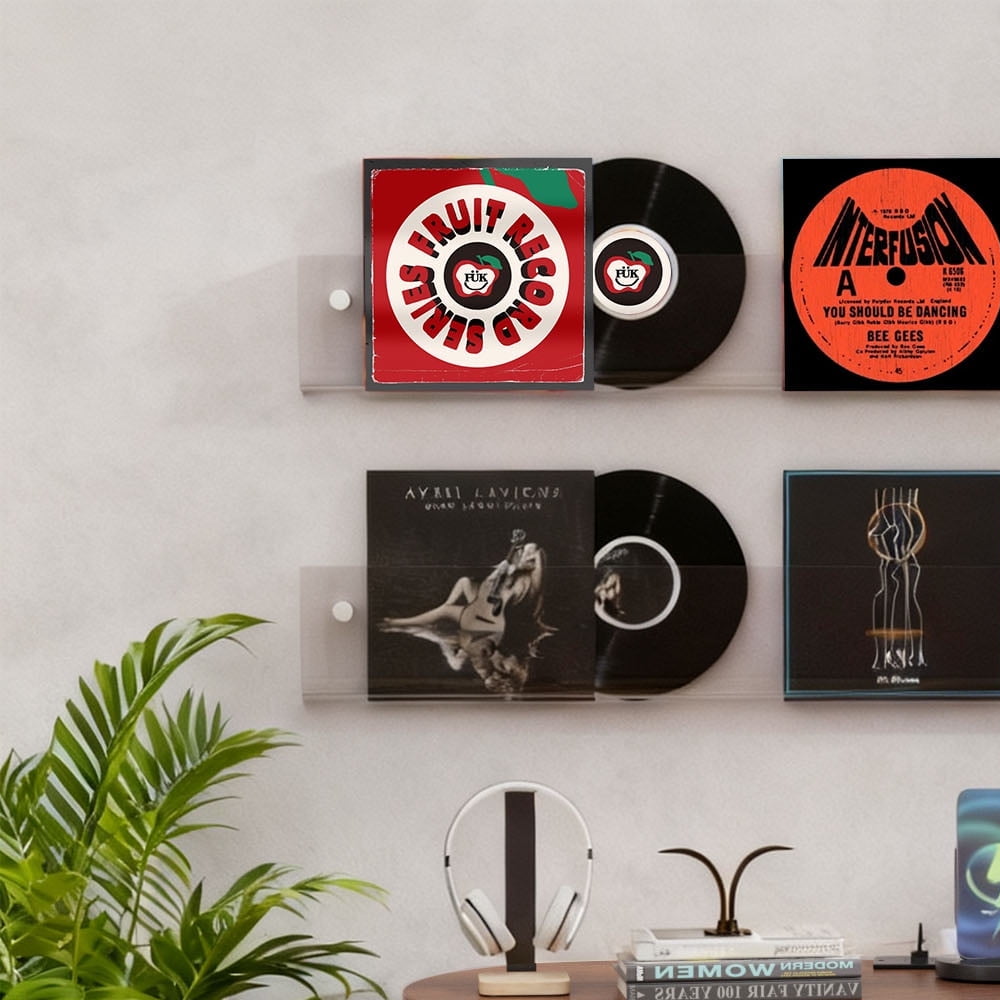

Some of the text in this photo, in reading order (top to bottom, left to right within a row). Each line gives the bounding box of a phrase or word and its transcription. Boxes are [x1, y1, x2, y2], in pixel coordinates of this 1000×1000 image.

[813, 192, 987, 267] INTERFUSION
[400, 198, 556, 354] FRUIT RECORD SERIES
[837, 270, 857, 297] A
[823, 305, 968, 319] YOU SHOULD BE DANCING
[867, 330, 924, 342] BEE GEES
